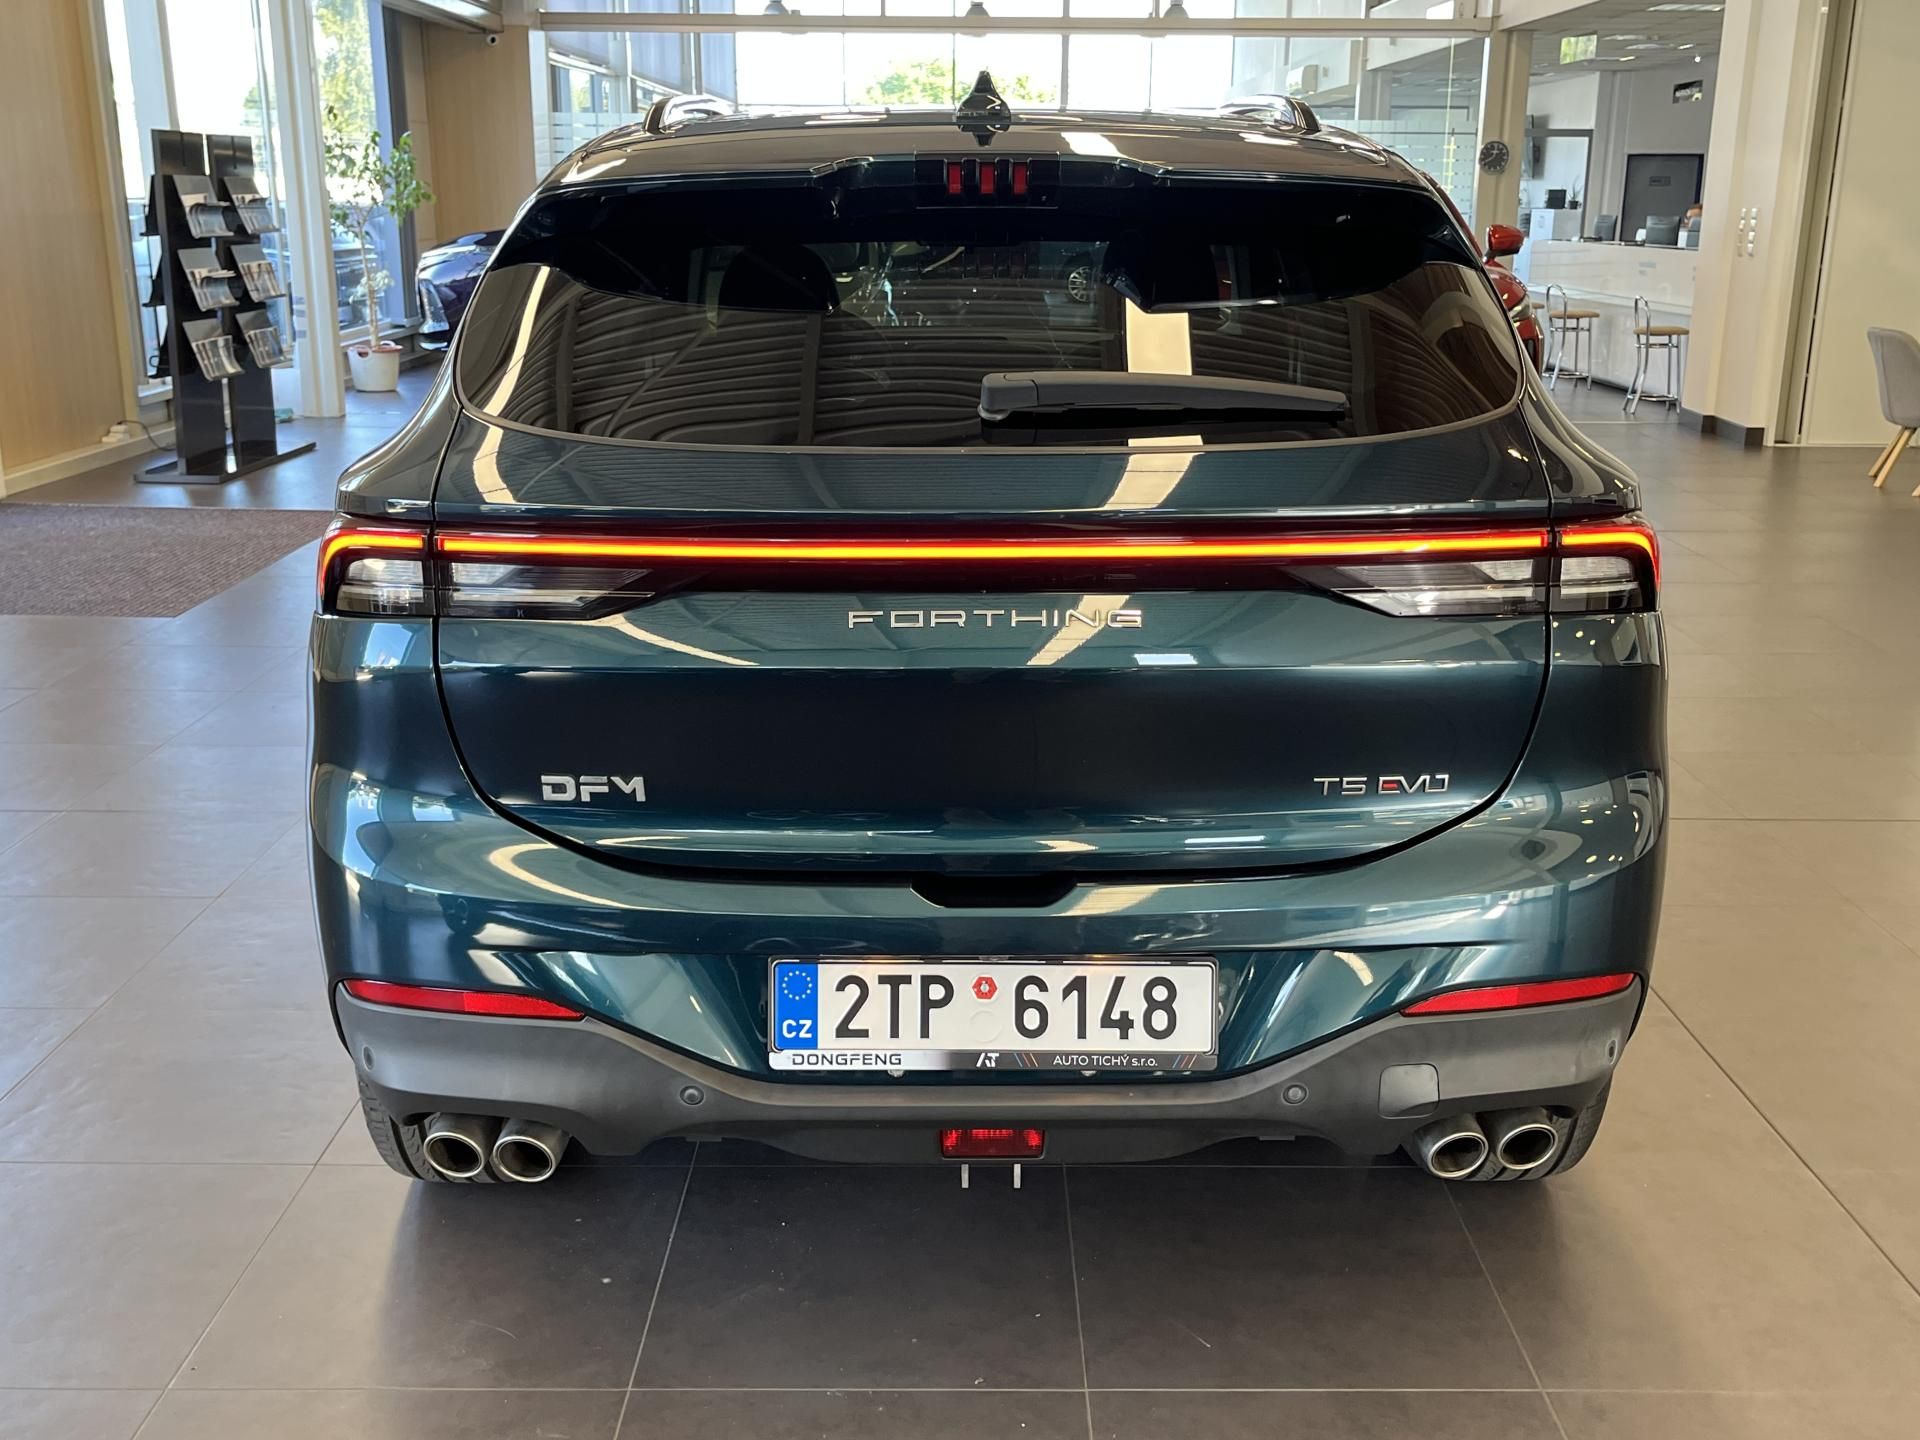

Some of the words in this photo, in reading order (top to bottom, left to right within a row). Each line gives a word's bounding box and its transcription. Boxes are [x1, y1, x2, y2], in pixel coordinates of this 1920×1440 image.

[848, 608, 1143, 629] FORTHING
[541, 775, 646, 802] DFM
[1313, 777, 1368, 796] T5
[834, 974, 955, 1039] 2TP
[1013, 975, 1178, 1040] 6148
[781, 1018, 813, 1039] CZ
[792, 1053, 902, 1066] DONGFENG
[1053, 1055, 1089, 1067] AUTO
[1091, 1053, 1129, 1067] TICHÝ
[1131, 1057, 1158, 1067] s.r.o.
